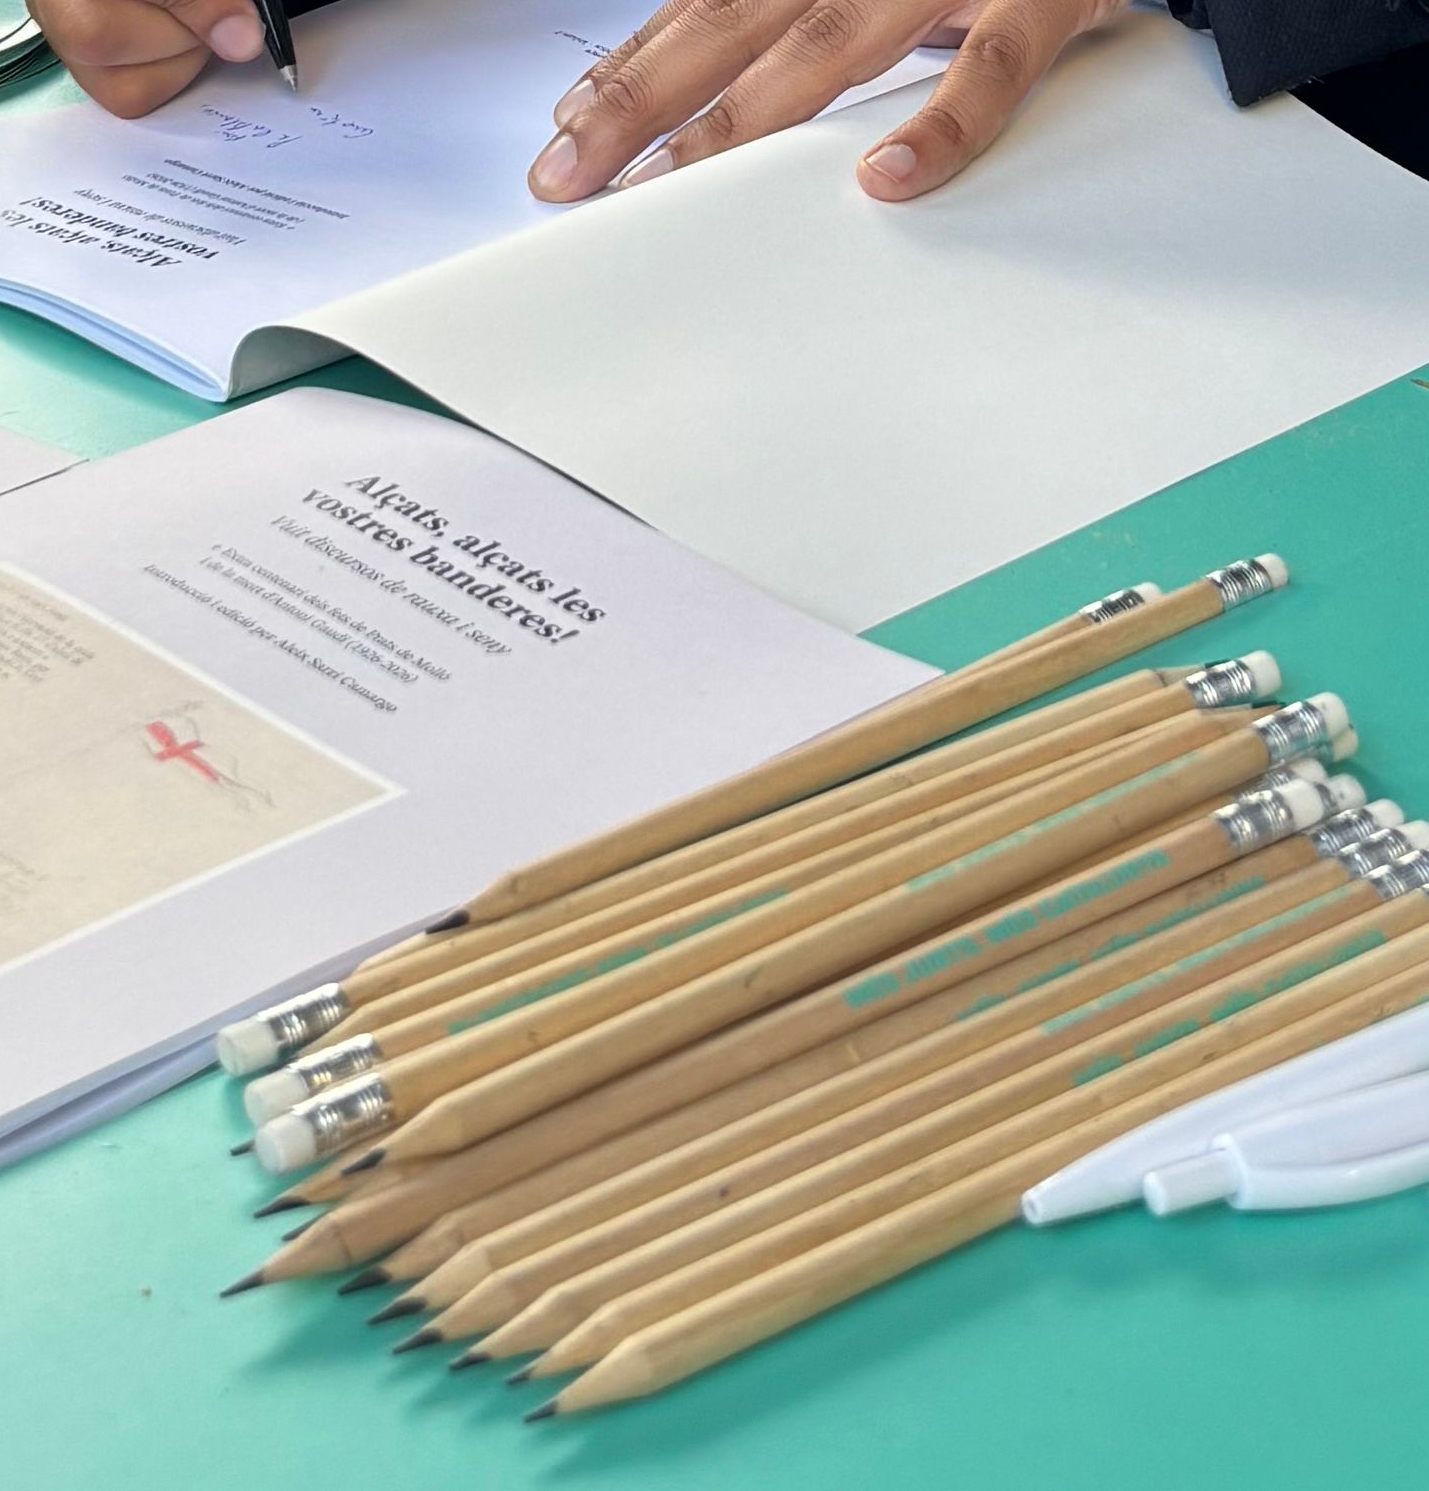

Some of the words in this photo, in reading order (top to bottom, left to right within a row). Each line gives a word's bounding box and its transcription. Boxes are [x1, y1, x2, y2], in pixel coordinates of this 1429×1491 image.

[205, 559, 224, 573] de
[219, 565, 235, 581] la
[232, 575, 265, 595] mort
[309, 618, 352, 644] Gaudí
[270, 514, 305, 539] Vuit
[305, 532, 384, 583] discursos
[380, 575, 407, 595] de
[405, 590, 457, 626] rauxa
[469, 625, 513, 658] seny
[302, 489, 413, 551] vostres
[409, 545, 579, 643] banderes!
[345, 476, 449, 537] Alçats,
[452, 535, 554, 592] alçats
[548, 585, 606, 624] les
[142, 564, 213, 603] Introducció
[215, 605, 256, 628] edició
[248, 626, 277, 640] per
[272, 639, 309, 662] Aleix
[339, 676, 397, 712] Camargo
[348, 619, 367, 634] de
[394, 646, 414, 662] de
